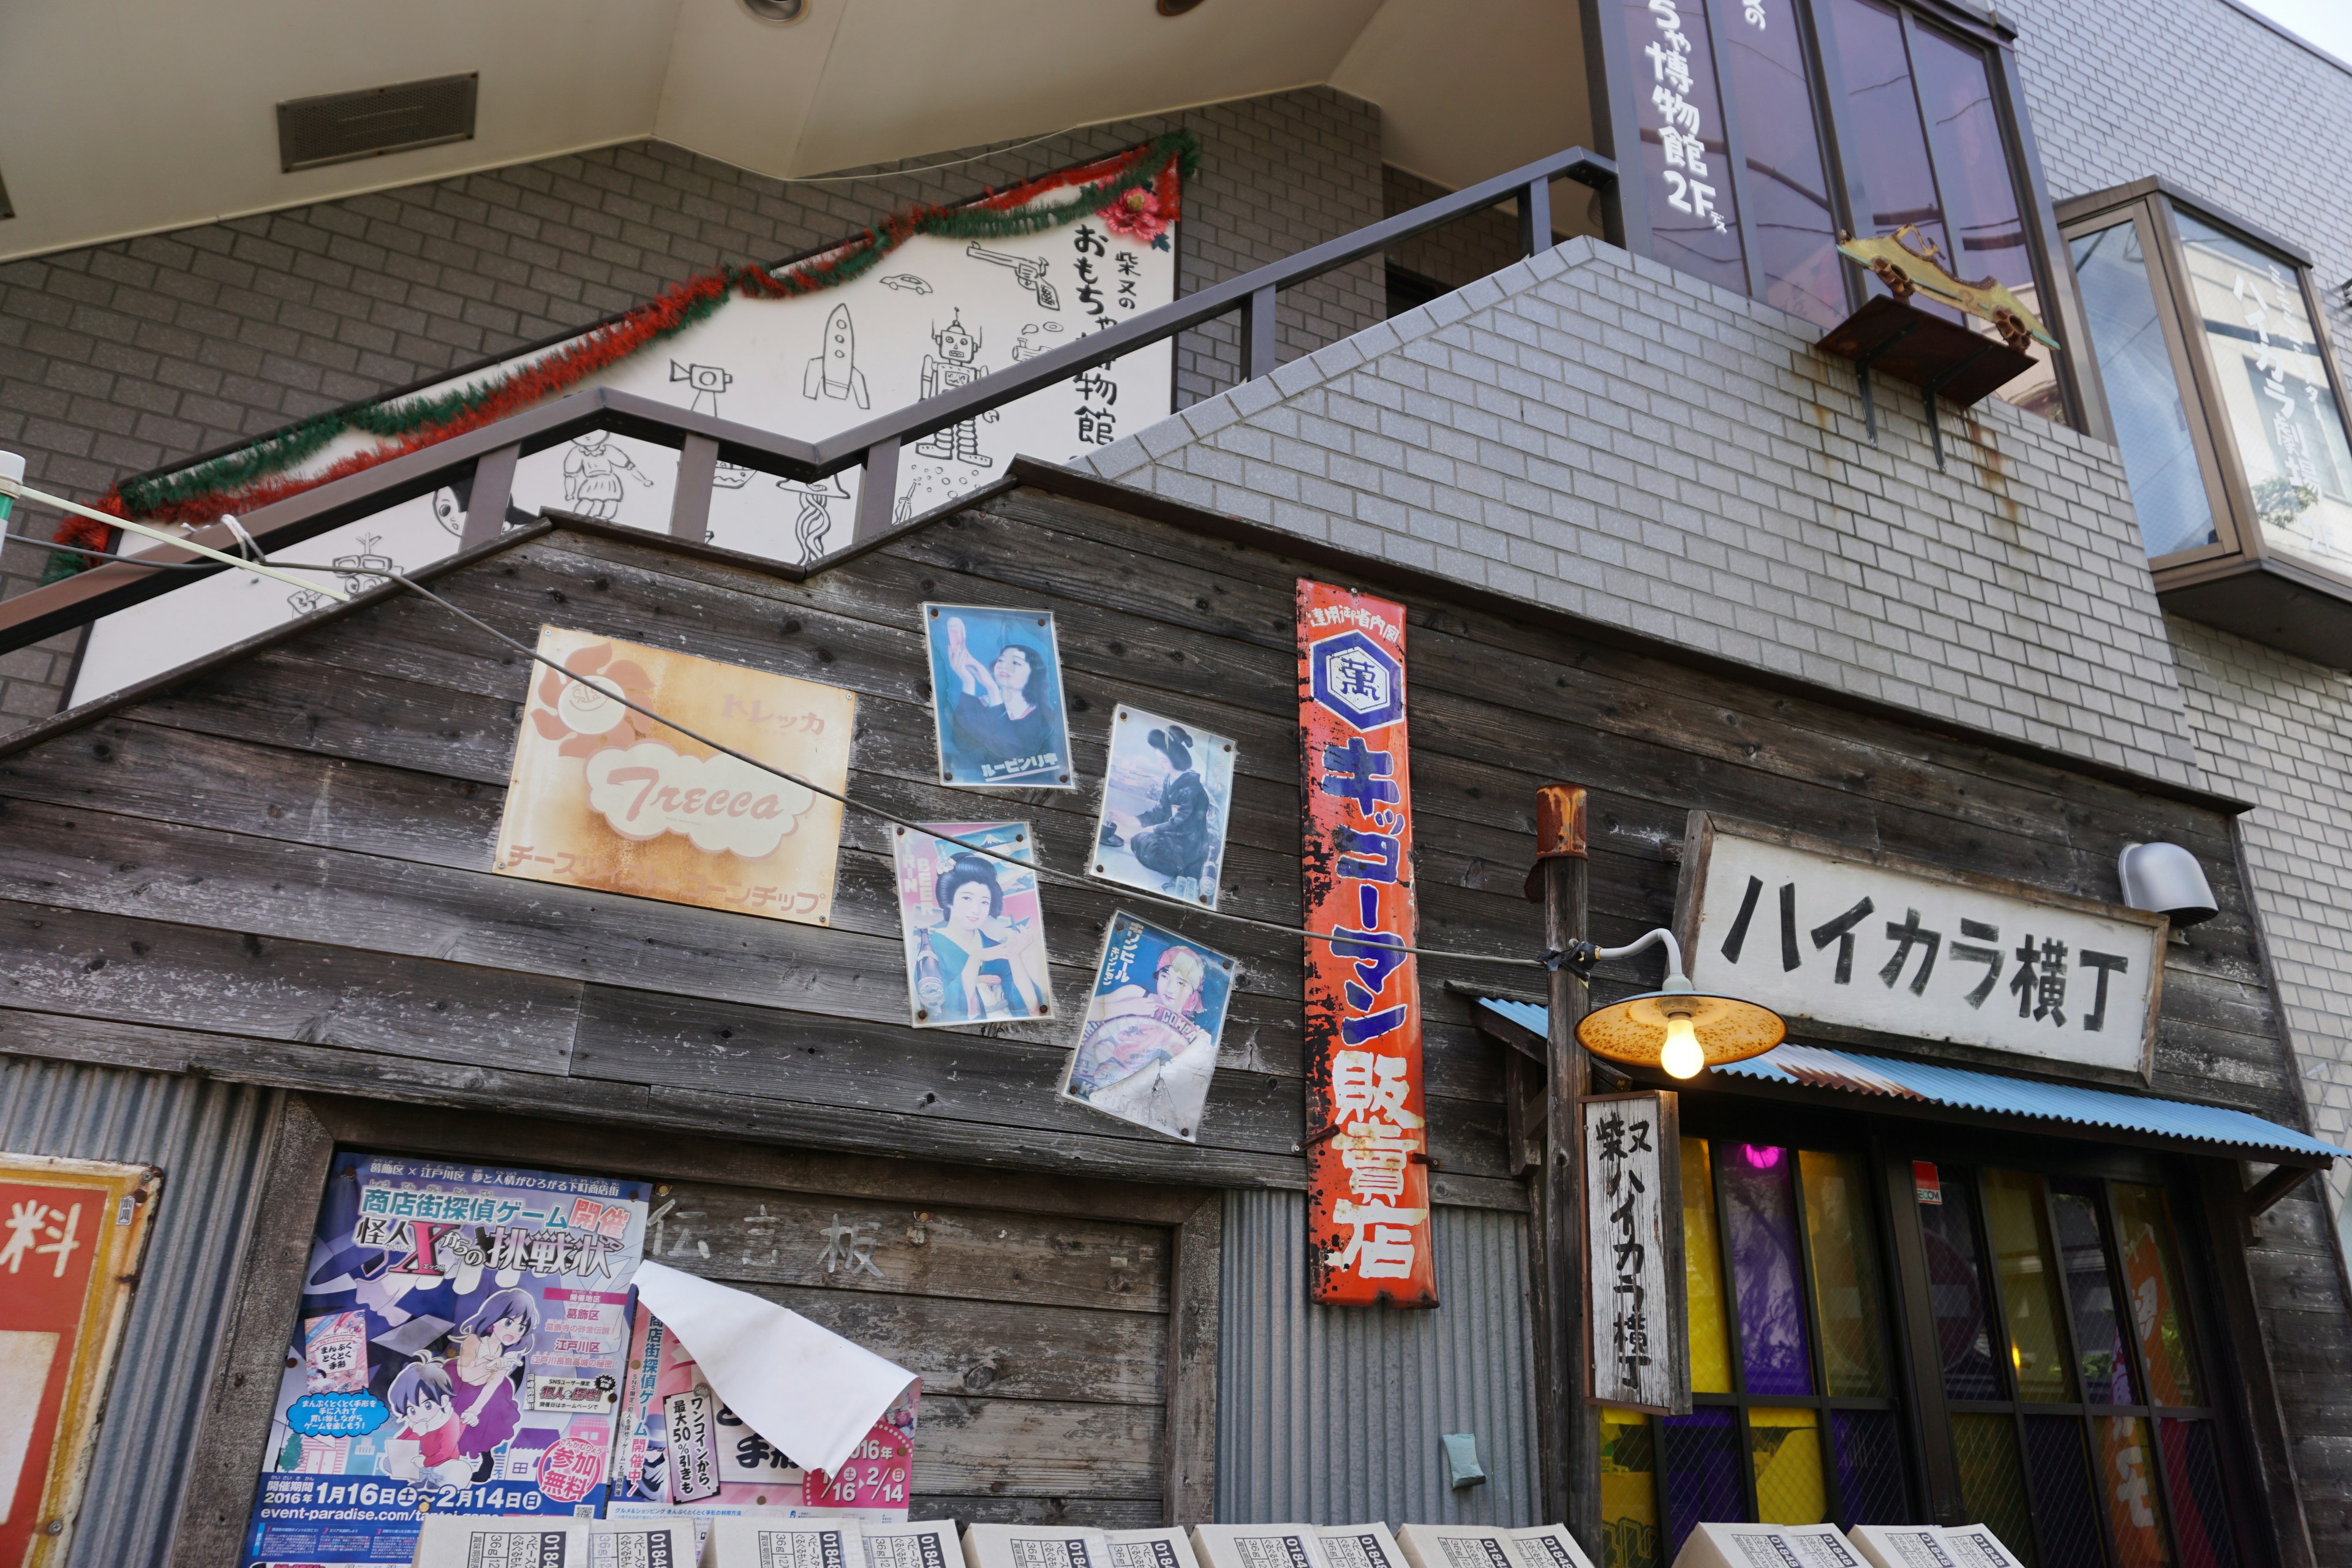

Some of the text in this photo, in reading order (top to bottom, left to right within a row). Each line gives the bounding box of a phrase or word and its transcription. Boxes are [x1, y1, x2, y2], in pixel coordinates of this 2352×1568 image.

[1114, 251, 1141, 310] 柴又の
[1073, 223, 1118, 446] おもちゃ物館
[721, 692, 826, 736] トレッカ
[507, 845, 827, 914] チーズツイスト コーンチップ
[917, 858, 935, 916] BEER
[1115, 921, 1145, 983] キリンビール
[1721, 874, 2128, 1033] ハイカラ横丁
[420, 1167, 466, 1182] 江戸川区
[471, 1170, 620, 1197] 夢と人情がひろがる下町商店街
[570, 1294, 601, 1303] 開催地区
[566, 1308, 600, 1321] 葛飾区
[320, 1342, 353, 1354] まんぷく
[322, 1351, 352, 1363] とくとく
[554, 1339, 601, 1353] 江戸川区
[328, 1360, 346, 1370] 手形
[301, 1400, 377, 1408] まんぷくとくとく手形を
[539, 1385, 603, 1402] 犯人を探せ!
[539, 1401, 598, 1410] 開催日はホームページで
[311, 1414, 363, 1423] 買い物しながら
[552, 1446, 597, 1477] 参加
[559, 1438, 603, 1455] さんかむりょう
[673, 1400, 694, 1495] 最大50%引きも
[263, 1492, 313, 1504] 2016年
[266, 1480, 315, 1493] 開催期間
[541, 1469, 587, 1502] 無料
[488, 1535, 502, 1556] 36g
[598, 1536, 611, 1556] 36g
[775, 1534, 786, 1553] 36g
[875, 1539, 886, 1557] 36g
[1027, 1542, 1037, 1561] 36g
[1763, 1537, 1787, 1568] ベビースター
[1771, 1536, 1799, 1567] 01848
[1815, 1537, 1840, 1568] ベビースター
[1823, 1536, 1853, 1567] 01848
[1913, 1535, 1940, 1567] ベビースター
[1921, 1535, 1951, 1567] 01848
[1967, 1536, 1994, 1568] ベビースター
[1973, 1535, 2005, 1567] 01848
